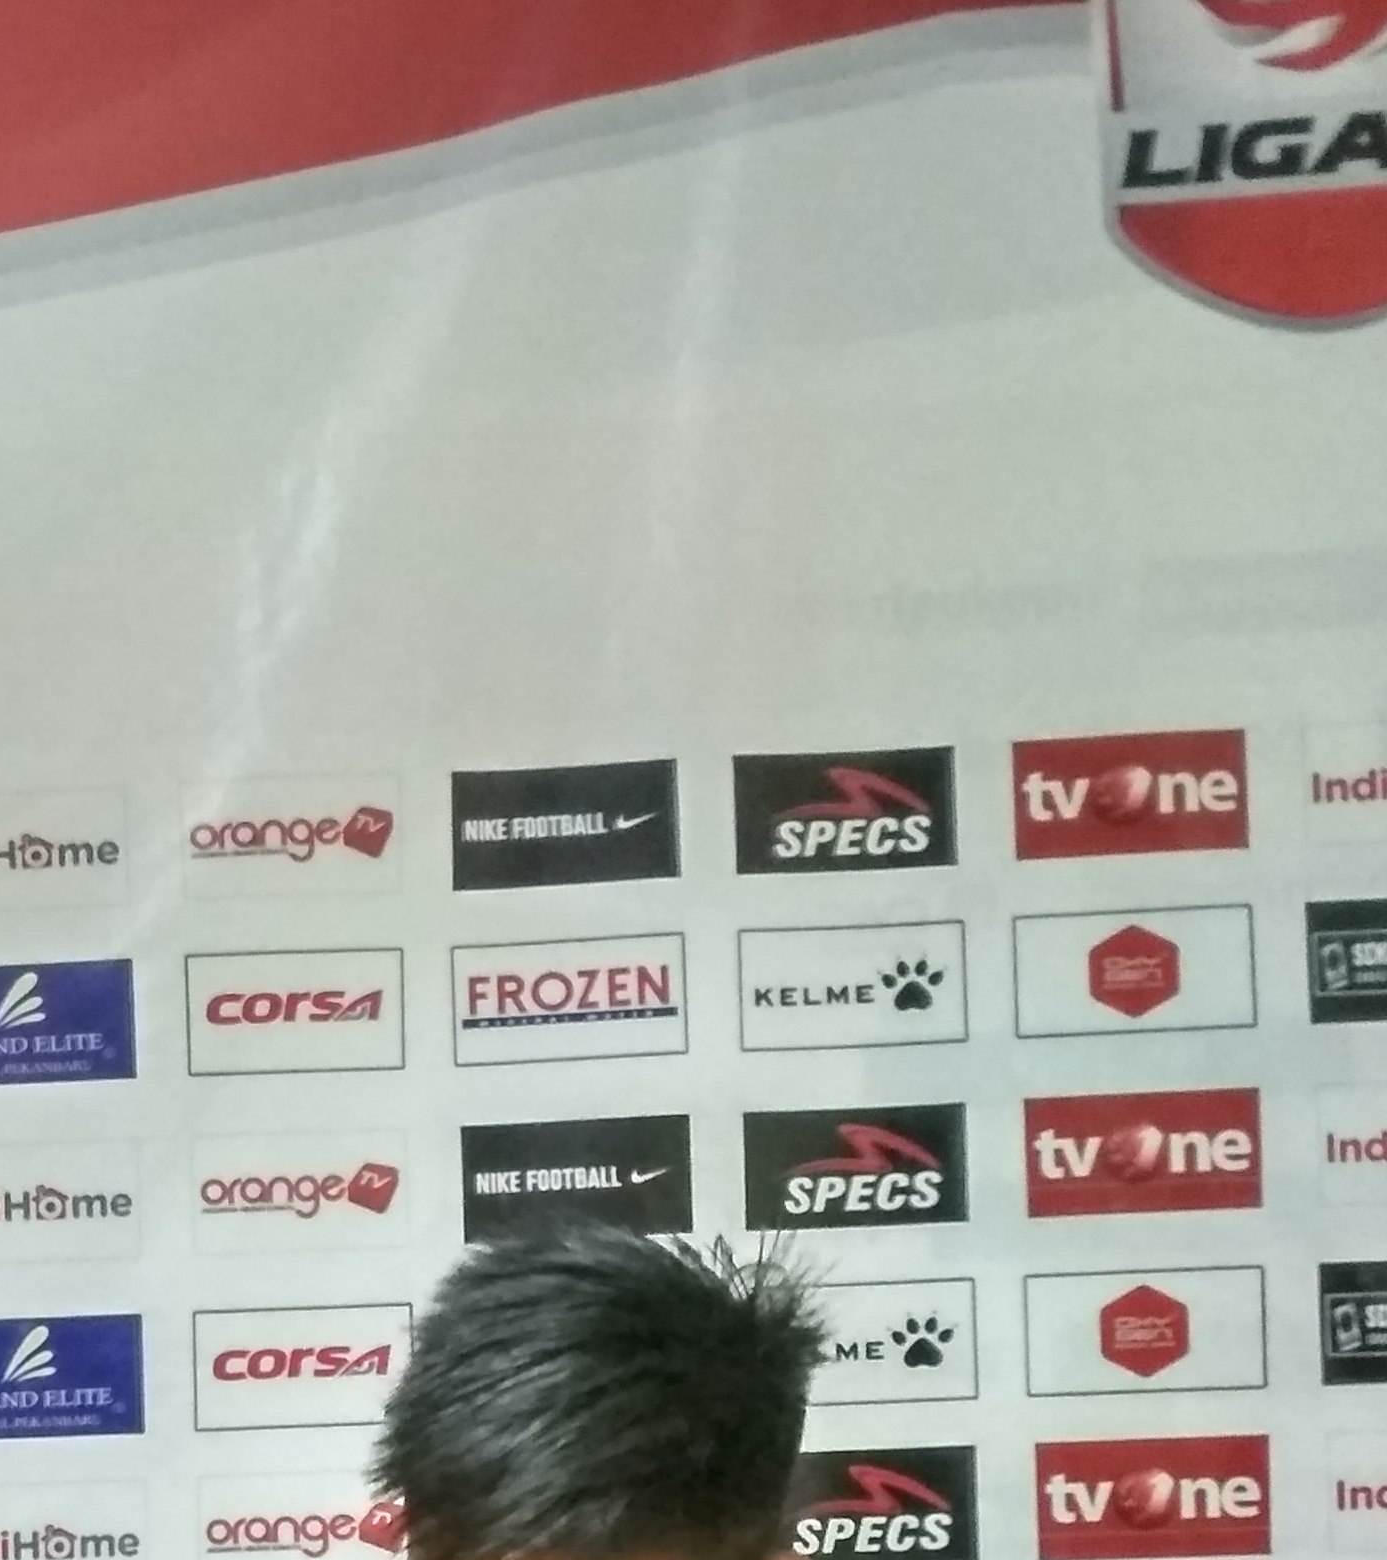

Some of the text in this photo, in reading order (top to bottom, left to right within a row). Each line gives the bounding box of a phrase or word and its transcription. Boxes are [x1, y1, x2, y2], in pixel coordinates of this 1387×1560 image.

[1023, 765, 1239, 823] tvOne
[190, 817, 343, 862] orange
[464, 812, 608, 843] NIKE FOOTBALL
[773, 814, 931, 858] SPECS
[468, 965, 669, 1015] FROZEN
[754, 983, 875, 1008] KELME
[34, 1033, 104, 1054] ELITE
[1035, 1124, 1252, 1182] tvOne
[201, 1173, 346, 1219] orange
[475, 1165, 622, 1194] NIKE FOOTBALL
[784, 1170, 942, 1216] SPECS
[43, 1387, 114, 1408] ELITE
[1045, 1467, 1261, 1525] tvOne
[206, 1514, 357, 1558] orange
[793, 1513, 953, 1556] SPECS
